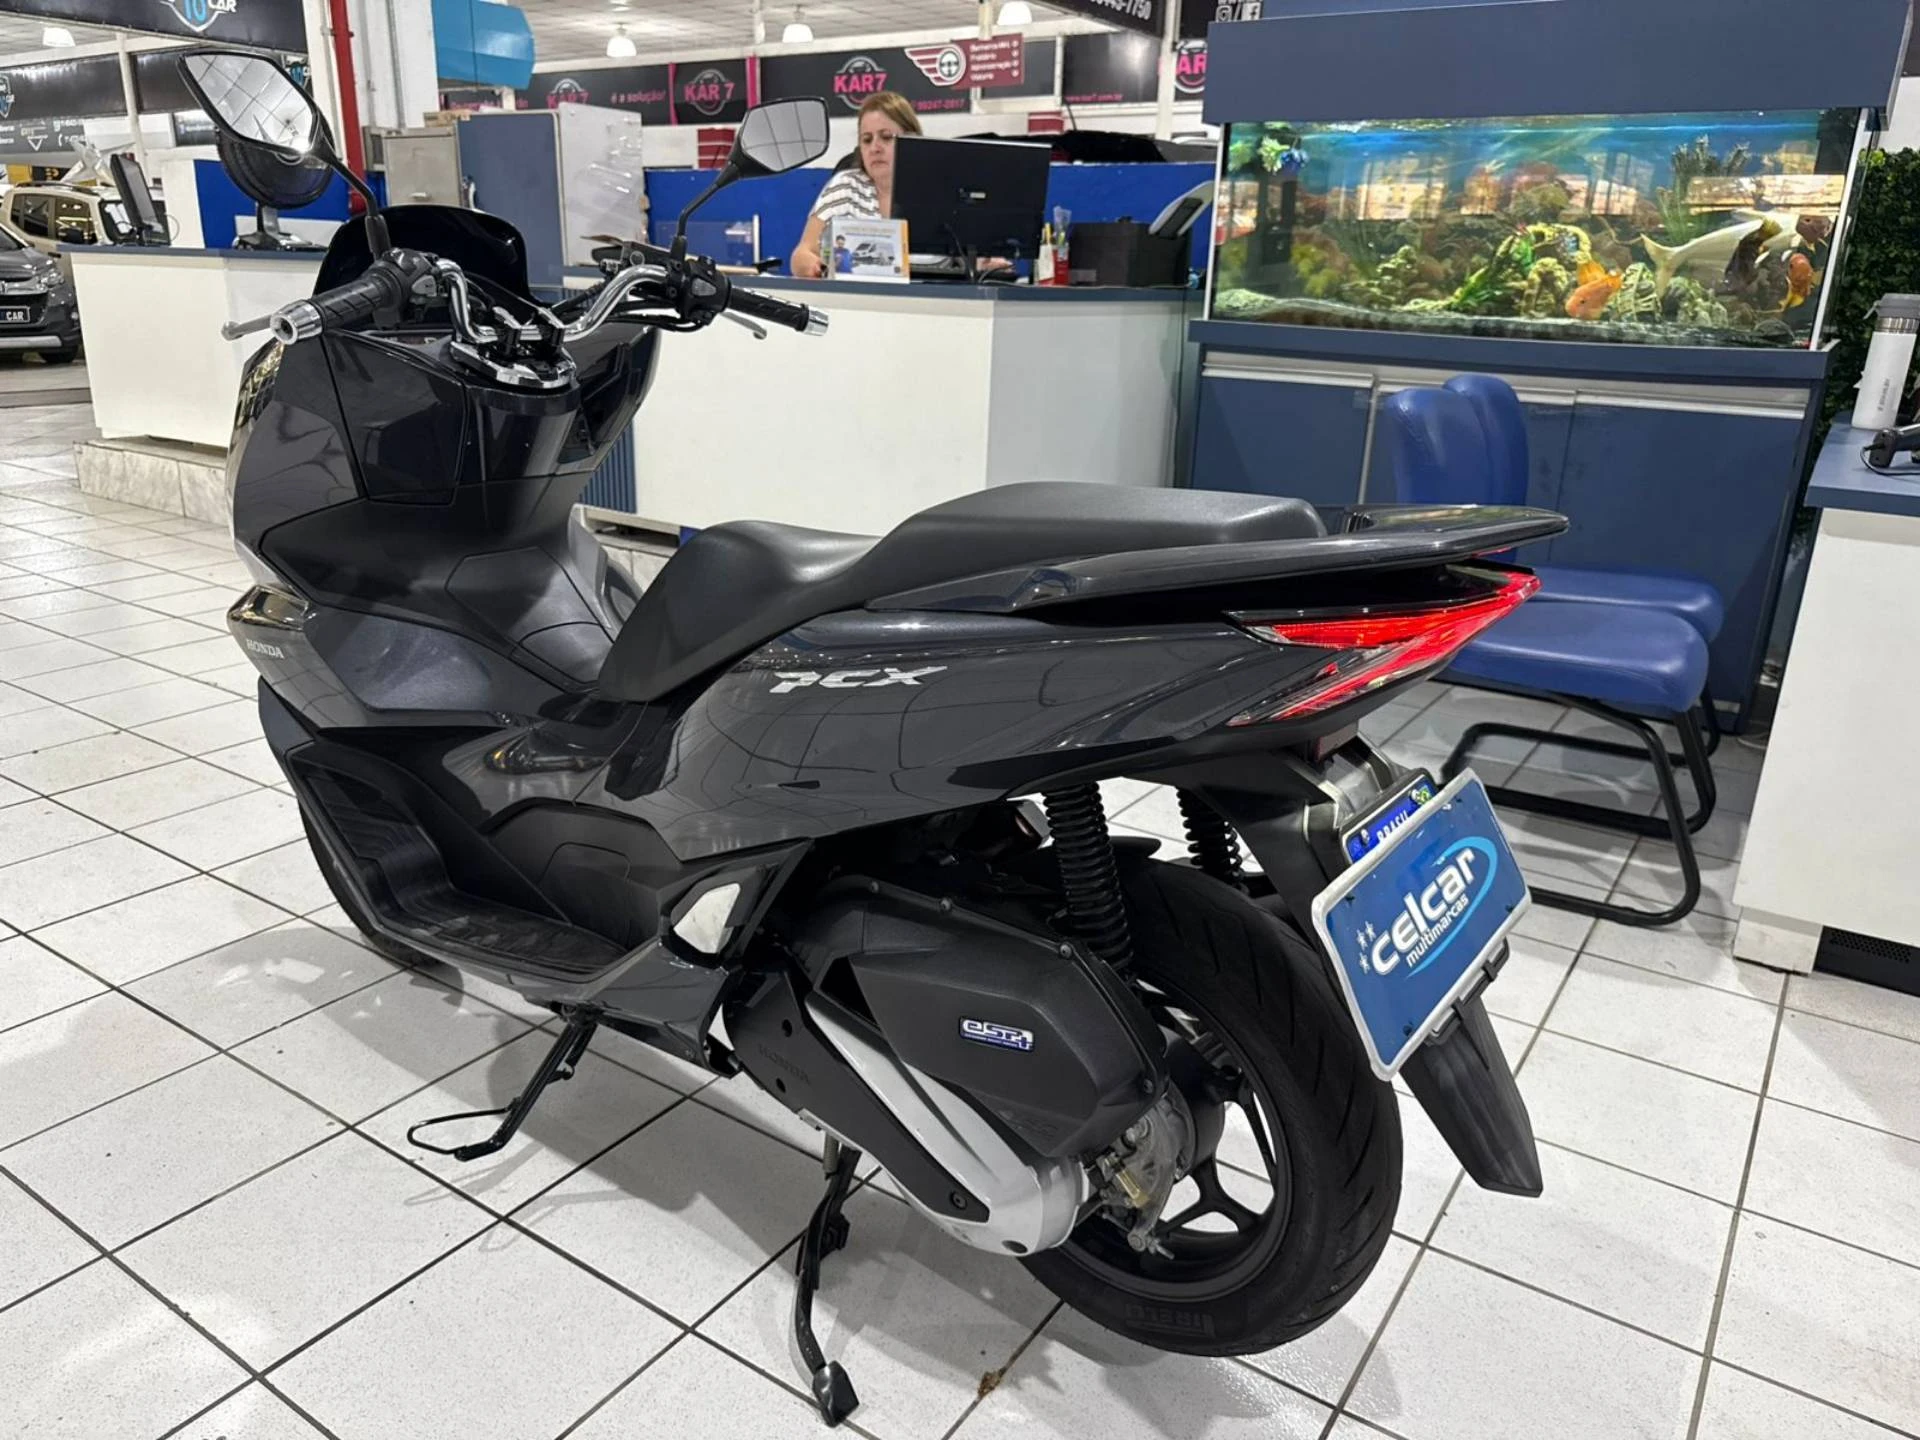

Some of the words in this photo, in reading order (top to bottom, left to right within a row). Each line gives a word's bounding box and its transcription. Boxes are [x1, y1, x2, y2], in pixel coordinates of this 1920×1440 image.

[834, 72, 888, 93] KAR7
[6, 311, 24, 321] CAR
[246, 638, 285, 660] HONDA
[769, 665, 948, 694] PCX
[1371, 847, 1476, 976] celcar
[1405, 894, 1470, 968] multimarcas
